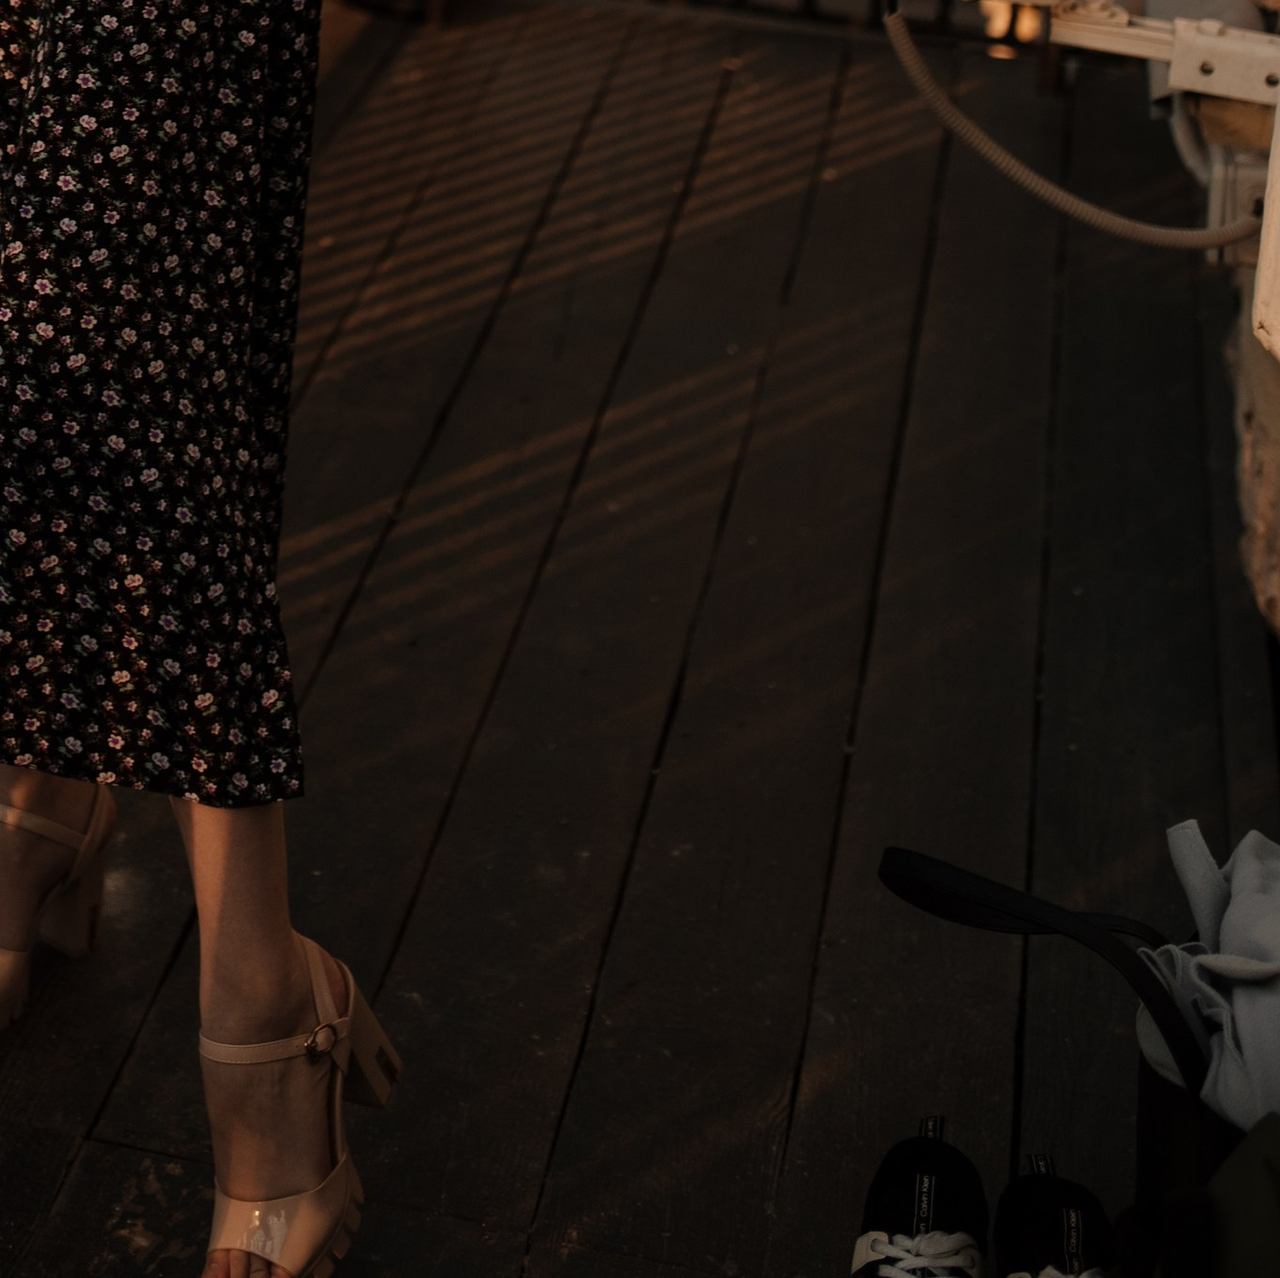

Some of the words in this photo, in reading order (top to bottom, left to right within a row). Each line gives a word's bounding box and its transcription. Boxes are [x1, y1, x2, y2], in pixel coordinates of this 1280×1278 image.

[921, 1175, 929, 1192] Klein
[920, 1194, 928, 1217] Calvin
[1069, 1209, 1077, 1227] Klein
[1069, 1229, 1077, 1253] Calvin
